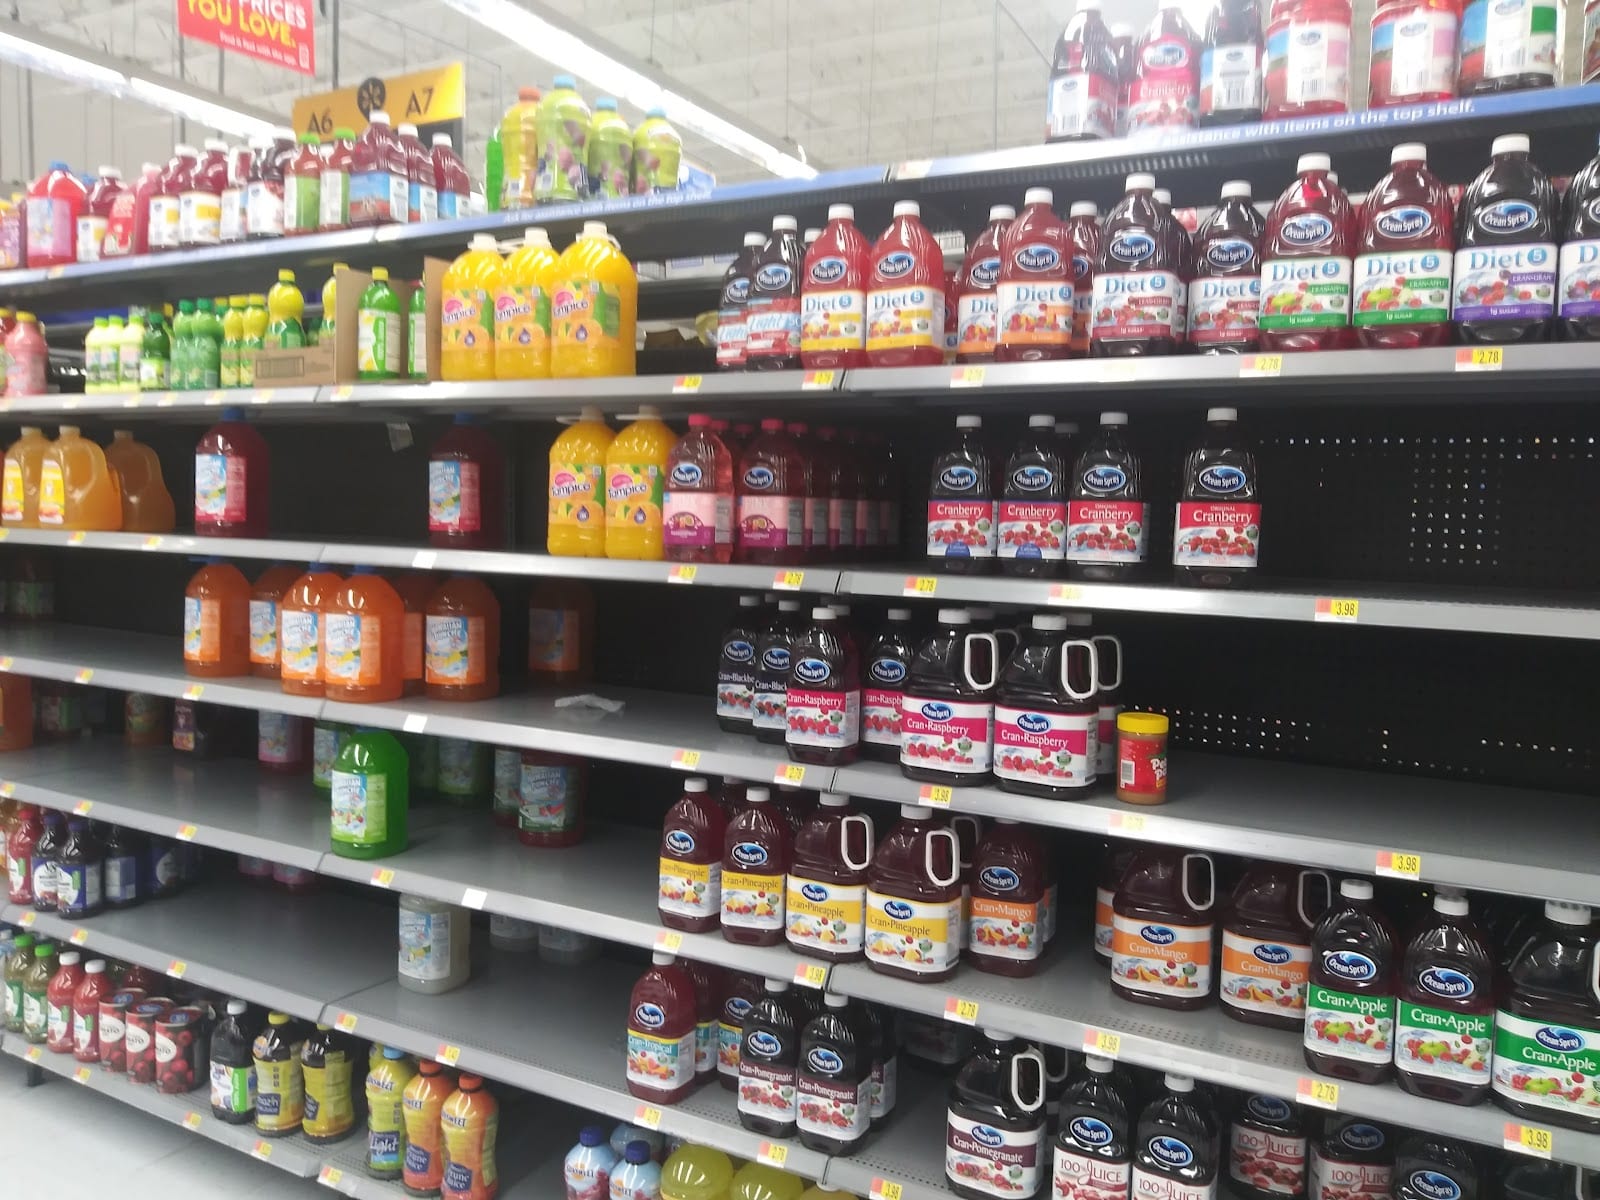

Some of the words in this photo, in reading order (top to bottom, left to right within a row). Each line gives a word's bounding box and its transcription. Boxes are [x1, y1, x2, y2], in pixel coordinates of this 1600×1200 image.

[189, 0, 232, 26] YOU
[405, 87, 434, 118] A7
[308, 106, 333, 136] A6
[1245, 124, 1279, 137] with
[1284, 119, 1329, 132] items
[1335, 117, 1356, 128] on
[1360, 109, 1390, 125] the
[1393, 106, 1423, 122] top
[1382, 219, 1403, 232] Ocean
[1403, 216, 1423, 231] Spray
[1484, 215, 1507, 227] Ocean
[1507, 212, 1529, 227] Spray
[1285, 226, 1305, 239] Ocean
[1305, 224, 1324, 239] Spray
[1211, 248, 1229, 260] Ocean
[1471, 251, 1523, 270] Diet
[1533, 248, 1542, 261] 5
[1368, 254, 1417, 274] Diet
[1272, 263, 1317, 281] Diet
[1105, 278, 1146, 294] Diet
[1204, 282, 1246, 298] Diet
[874, 293, 907, 309] Diet
[1016, 287, 1055, 301] Diet
[805, 296, 835, 311] Diet
[1261, 358, 1278, 370] 2.78
[1479, 351, 1499, 363] 2.78
[1088, 475, 1104, 485] Ocean
[1104, 474, 1119, 487] Spray
[1204, 475, 1222, 487] Ocean
[1222, 475, 1239, 488] Spray
[937, 504, 984, 518] Cranberry
[1007, 505, 1057, 519] Cranberry
[1079, 509, 1133, 521] Cranberry
[1193, 510, 1251, 523] Cranberry
[1337, 602, 1355, 616] 3.98
[799, 666, 813, 676] Ocean
[874, 666, 888, 676] Ocean
[924, 705, 937, 716] Ocean
[937, 707, 950, 720] Spray
[1019, 717, 1034, 728] Ocean
[1033, 718, 1048, 732] Spray
[735, 849, 750, 859] Ocean
[750, 851, 763, 863] Spray
[1398, 856, 1417, 871] 3.98
[983, 873, 999, 884] Ocean
[999, 874, 1014, 887] Spray
[803, 888, 816, 897] Ocean
[886, 906, 900, 916] Ocean
[1143, 929, 1158, 938] Ocean
[1158, 930, 1172, 942] Spray
[1256, 948, 1272, 958] Ocean
[1272, 950, 1288, 962] Spray
[1329, 959, 1348, 971] Ocean
[1348, 962, 1368, 977] Spray
[1424, 976, 1445, 989] Ocean
[1445, 979, 1466, 996] Spray
[961, 1002, 975, 1016] 2.78
[1101, 1035, 1117, 1051] 3.98
[1539, 1031, 1559, 1045] Ocean
[1559, 1034, 1579, 1049] Spray
[1317, 1083, 1335, 1098] 2.78
[973, 1128, 987, 1140] Ocean
[986, 1131, 1001, 1143] Spray
[1073, 1123, 1090, 1138] Ocean
[1090, 1128, 1107, 1140] Spray
[370, 1136, 398, 1156] Light
[1527, 1132, 1548, 1148] 3.98
[1152, 1142, 1169, 1156] Ocean
[1169, 1148, 1186, 1162] Spray
[1414, 1176, 1436, 1195] Ocean
[1435, 1183, 1454, 1198] Spray
